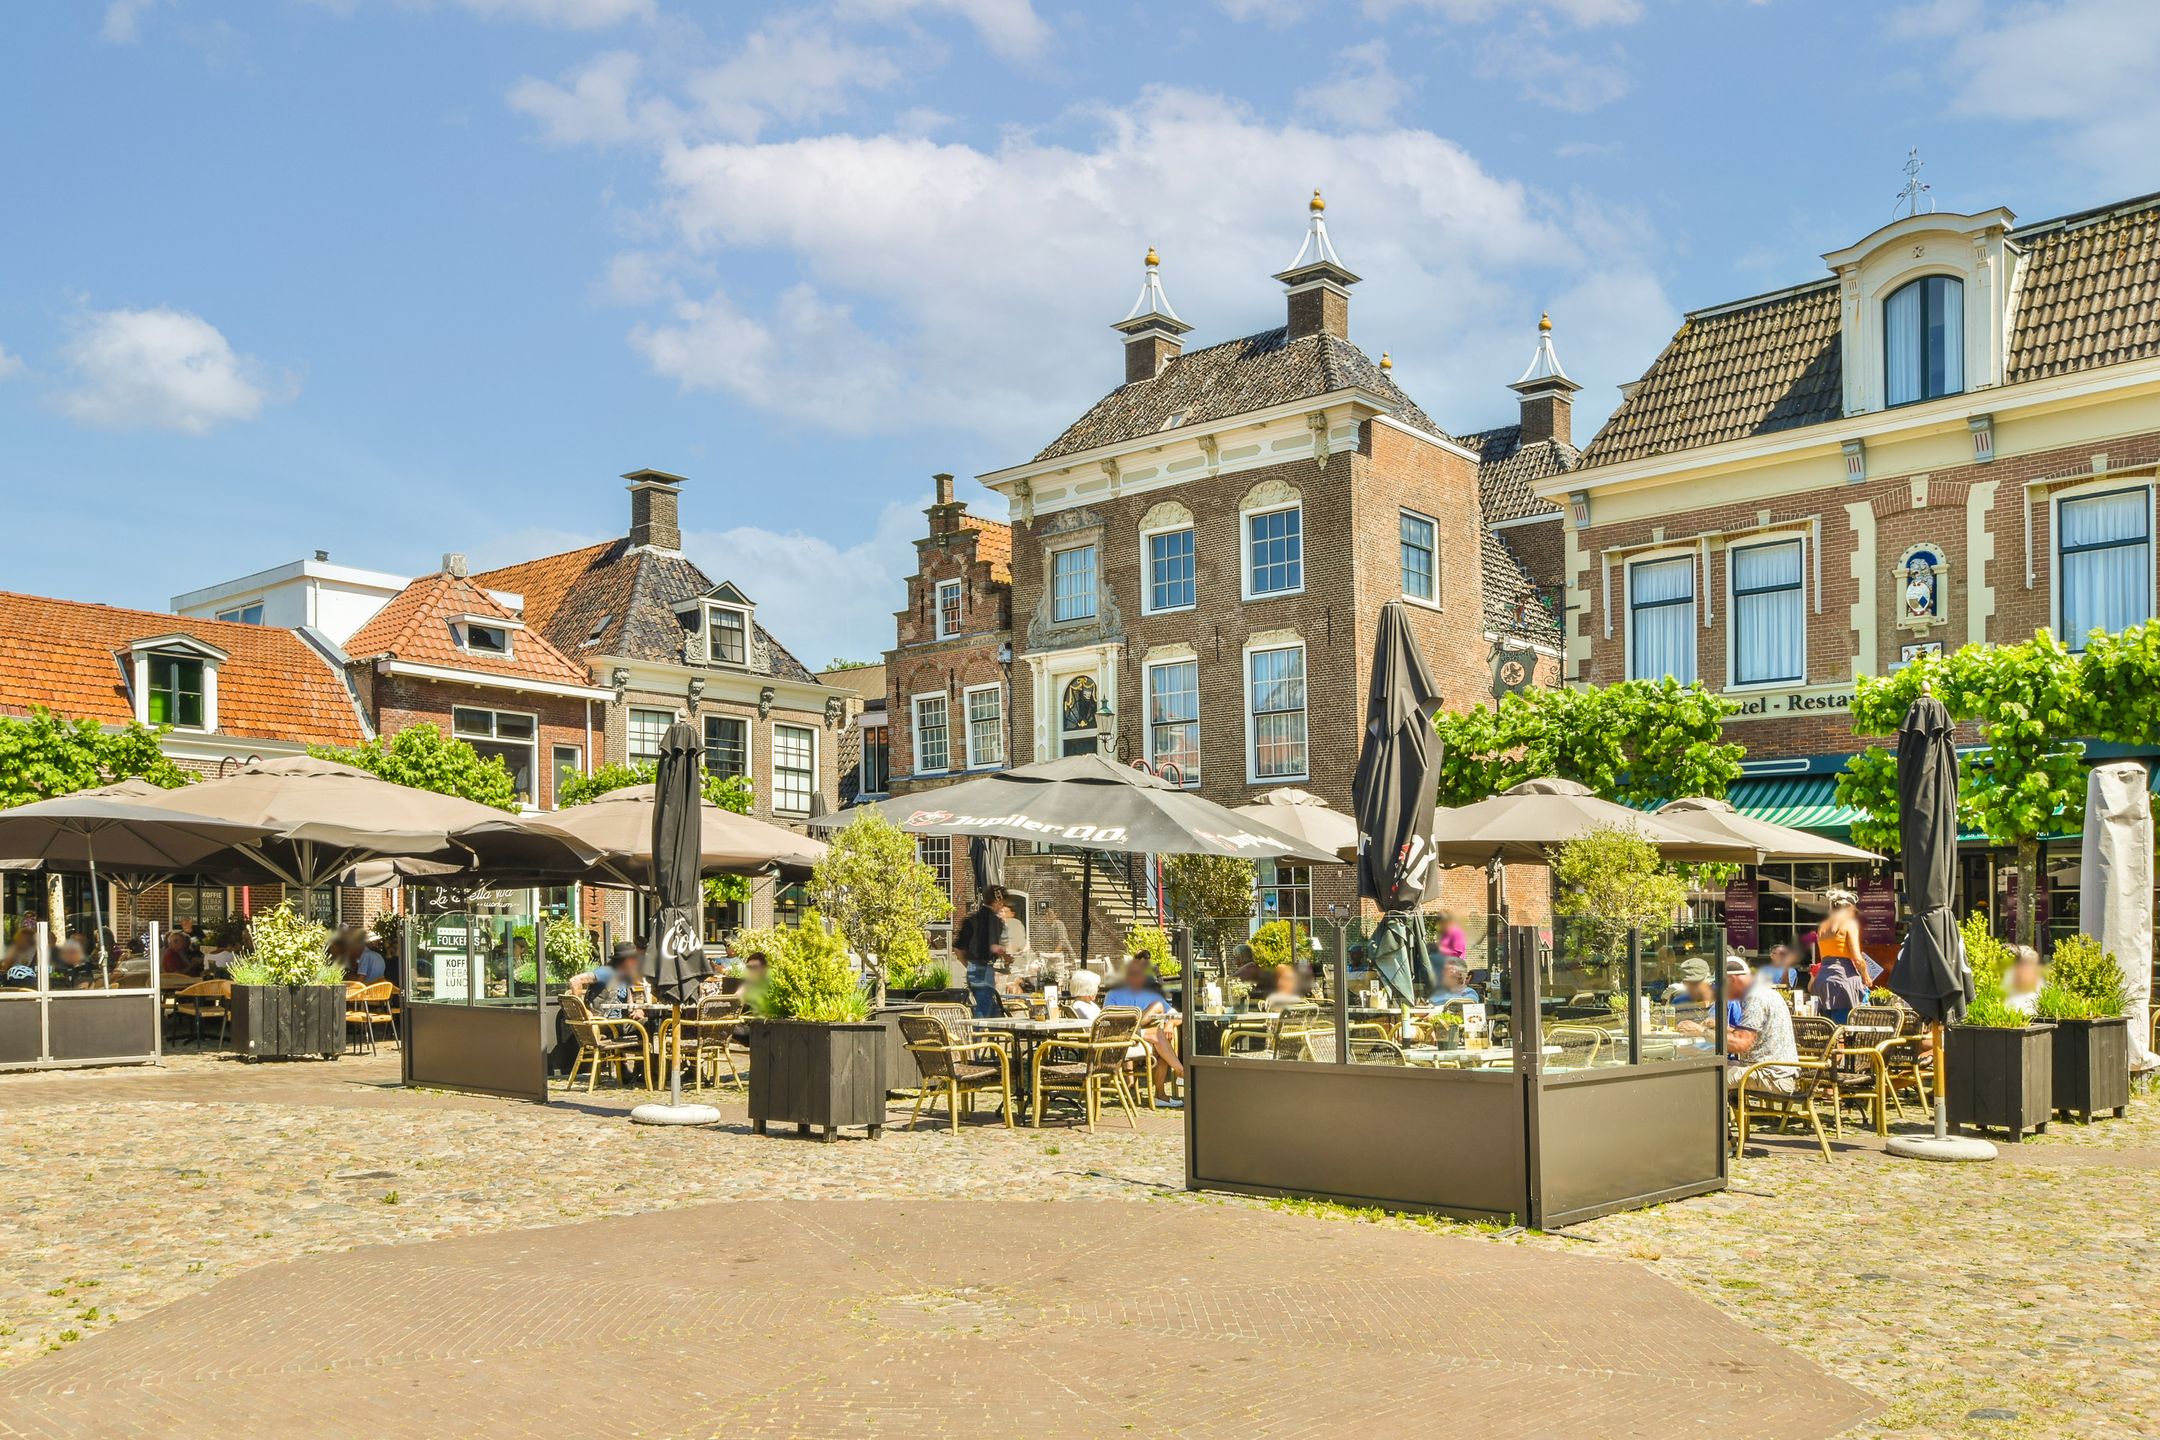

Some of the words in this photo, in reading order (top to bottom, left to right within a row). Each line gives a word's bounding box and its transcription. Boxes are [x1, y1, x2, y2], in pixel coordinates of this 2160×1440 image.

[1787, 694, 1855, 712] Resta
[940, 814, 1064, 833] Jupiler
[437, 935, 480, 947] FOLKES
[446, 959, 466, 968] KOFF
[446, 968, 468, 978] GEBA
[446, 978, 468, 987] LUNC
